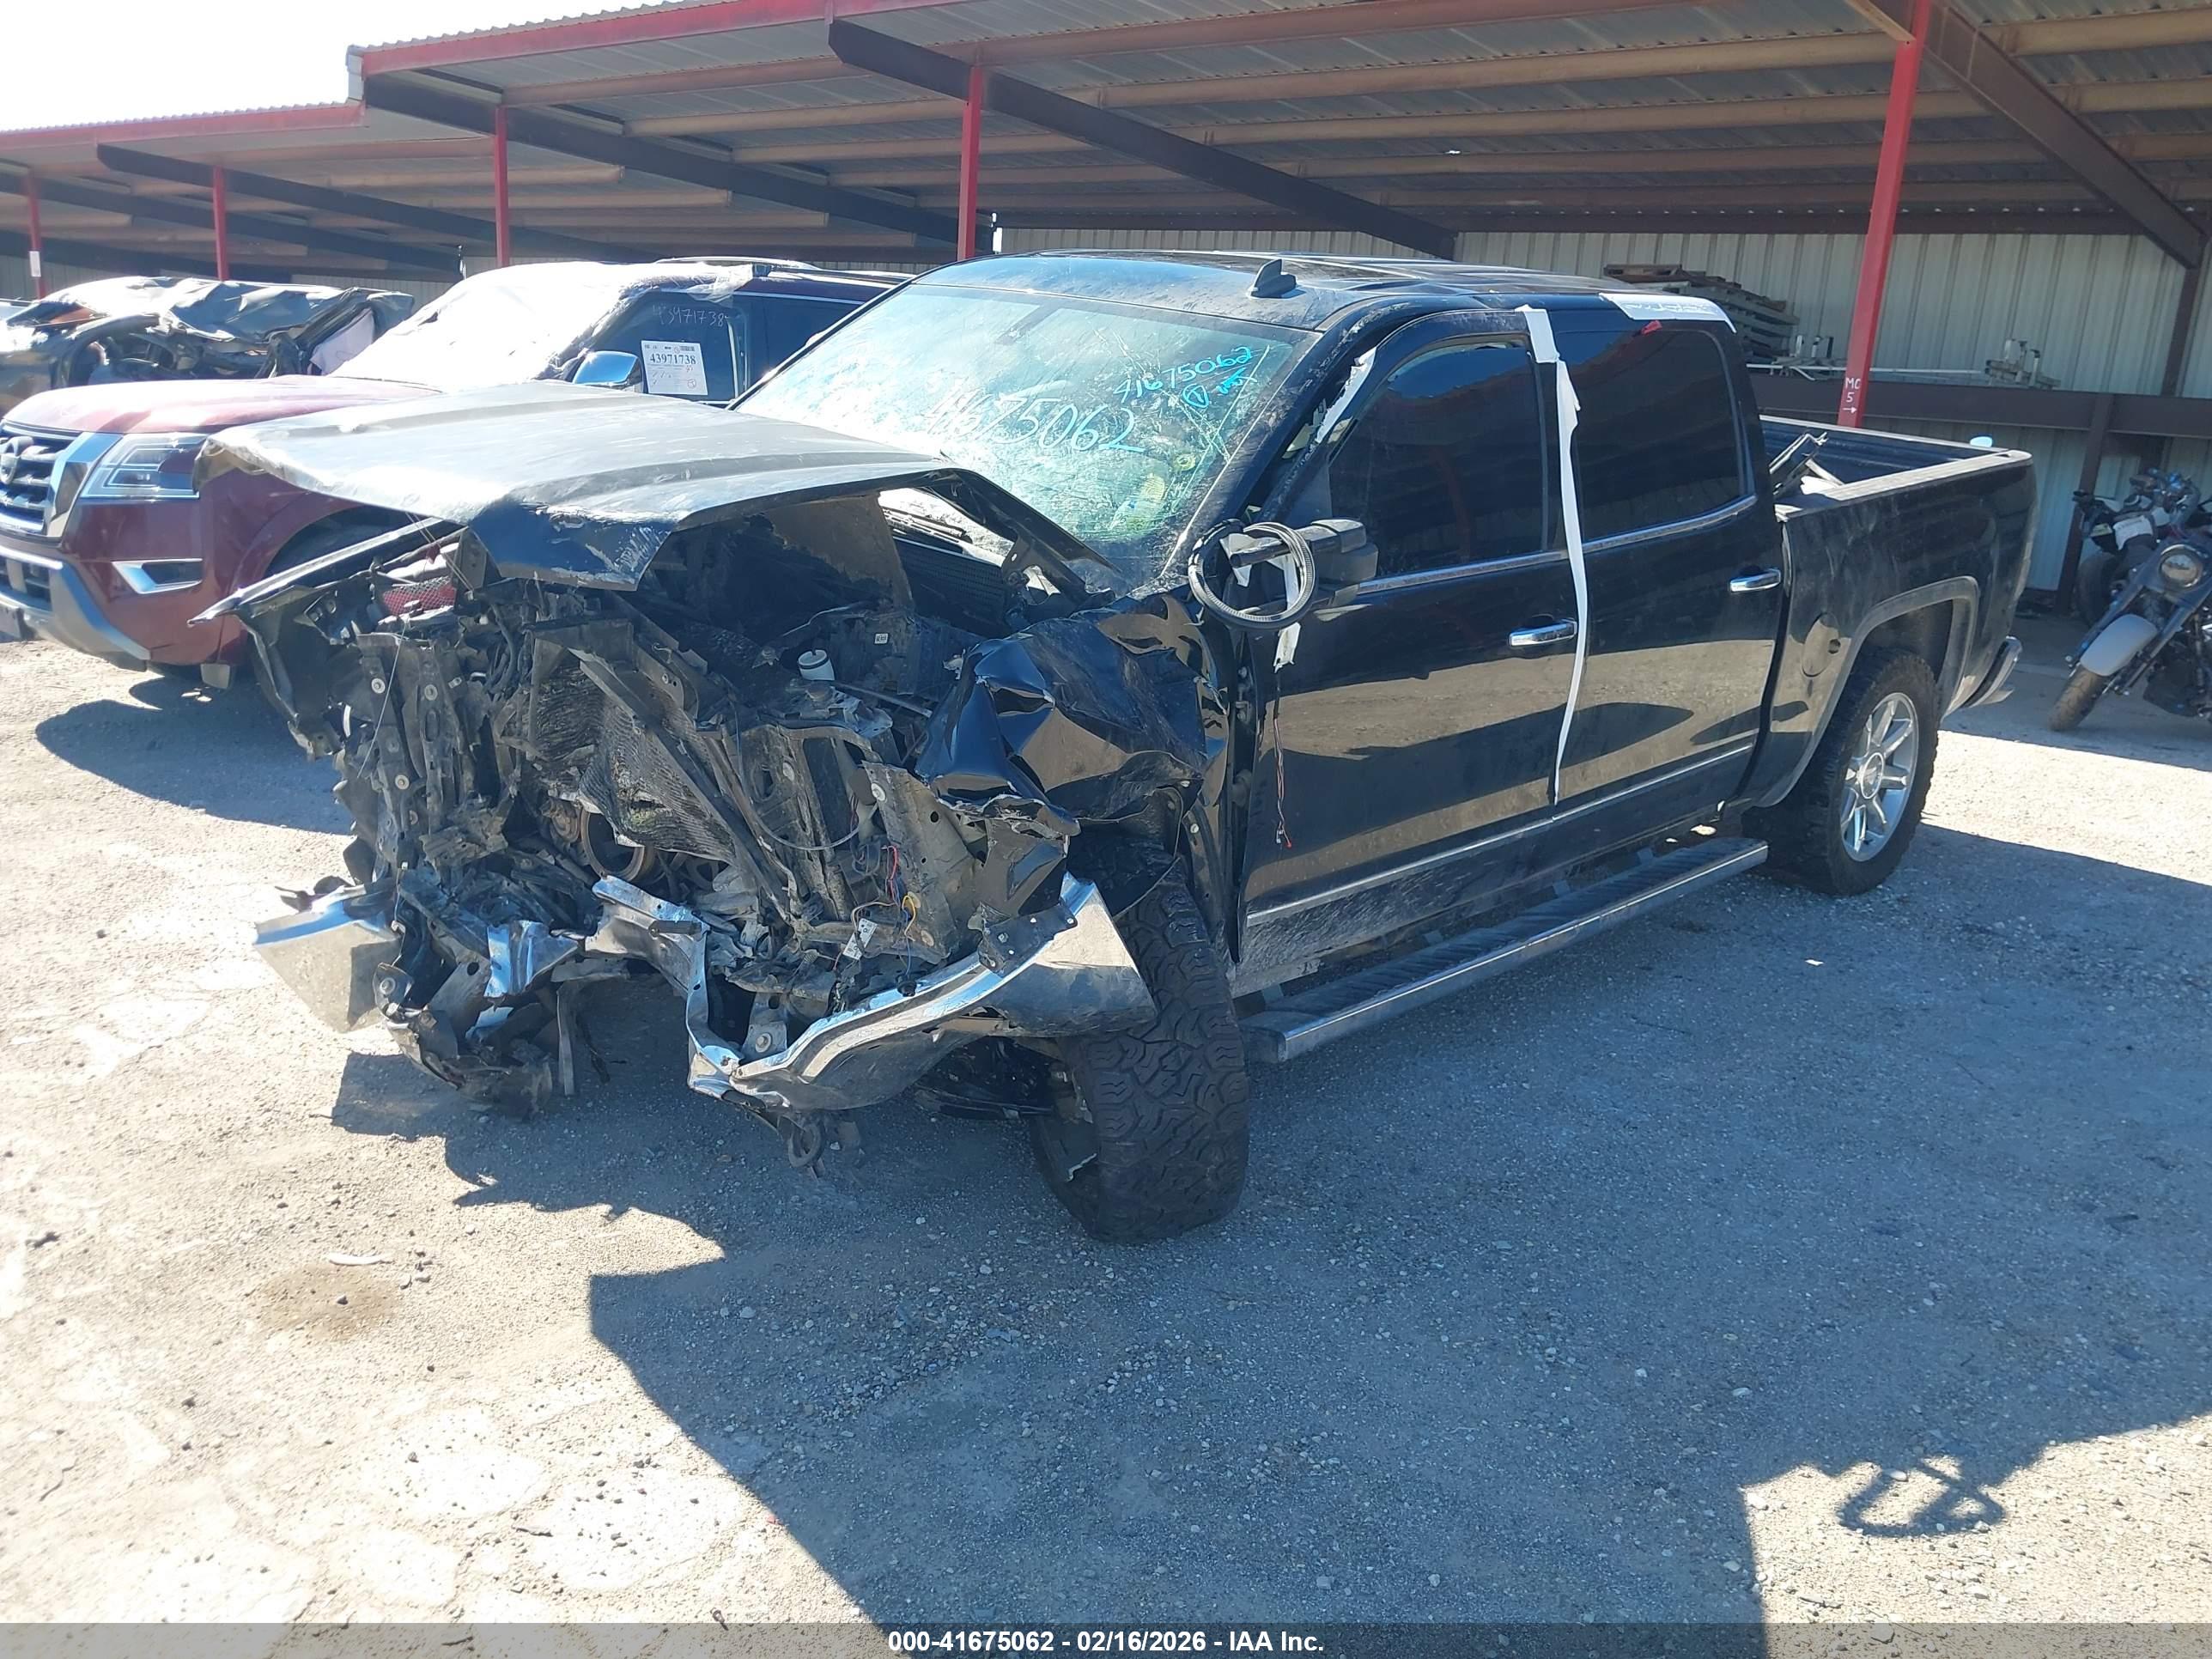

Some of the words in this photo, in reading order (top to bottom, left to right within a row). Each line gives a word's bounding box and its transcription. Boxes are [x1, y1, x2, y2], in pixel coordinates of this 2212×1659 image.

[649, 353, 696, 365] 43971738
[1113, 346, 1252, 404] 41675062
[1844, 377, 1862, 390] MC
[1845, 392, 1856, 403] 5
